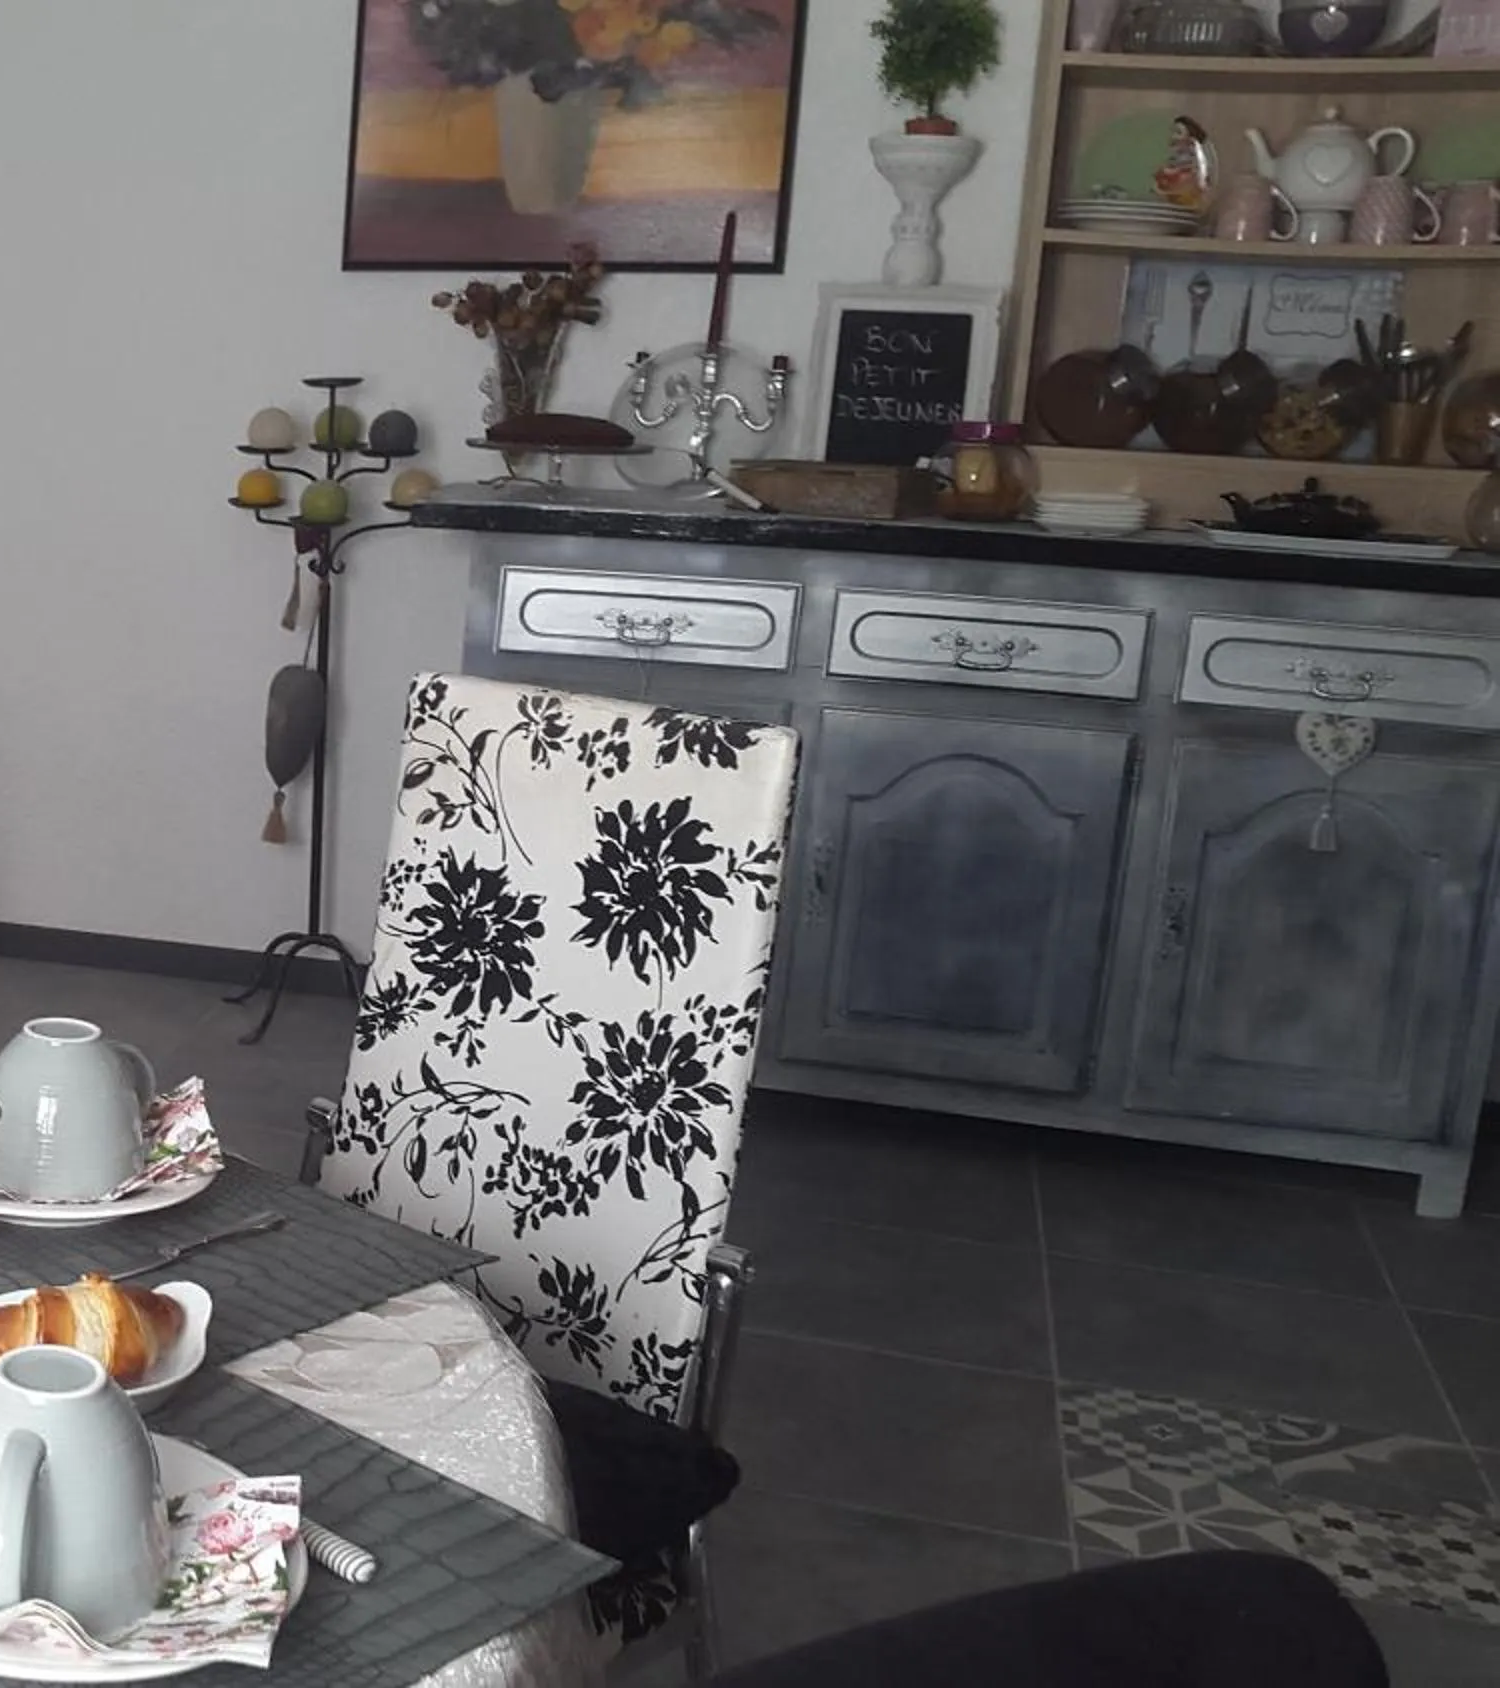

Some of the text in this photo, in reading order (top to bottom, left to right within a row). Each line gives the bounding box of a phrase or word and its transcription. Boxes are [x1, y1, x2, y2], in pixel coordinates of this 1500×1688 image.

[866, 325, 936, 353] BON
[851, 356, 938, 387] PETIT
[836, 394, 962, 425] DEJEUNER
